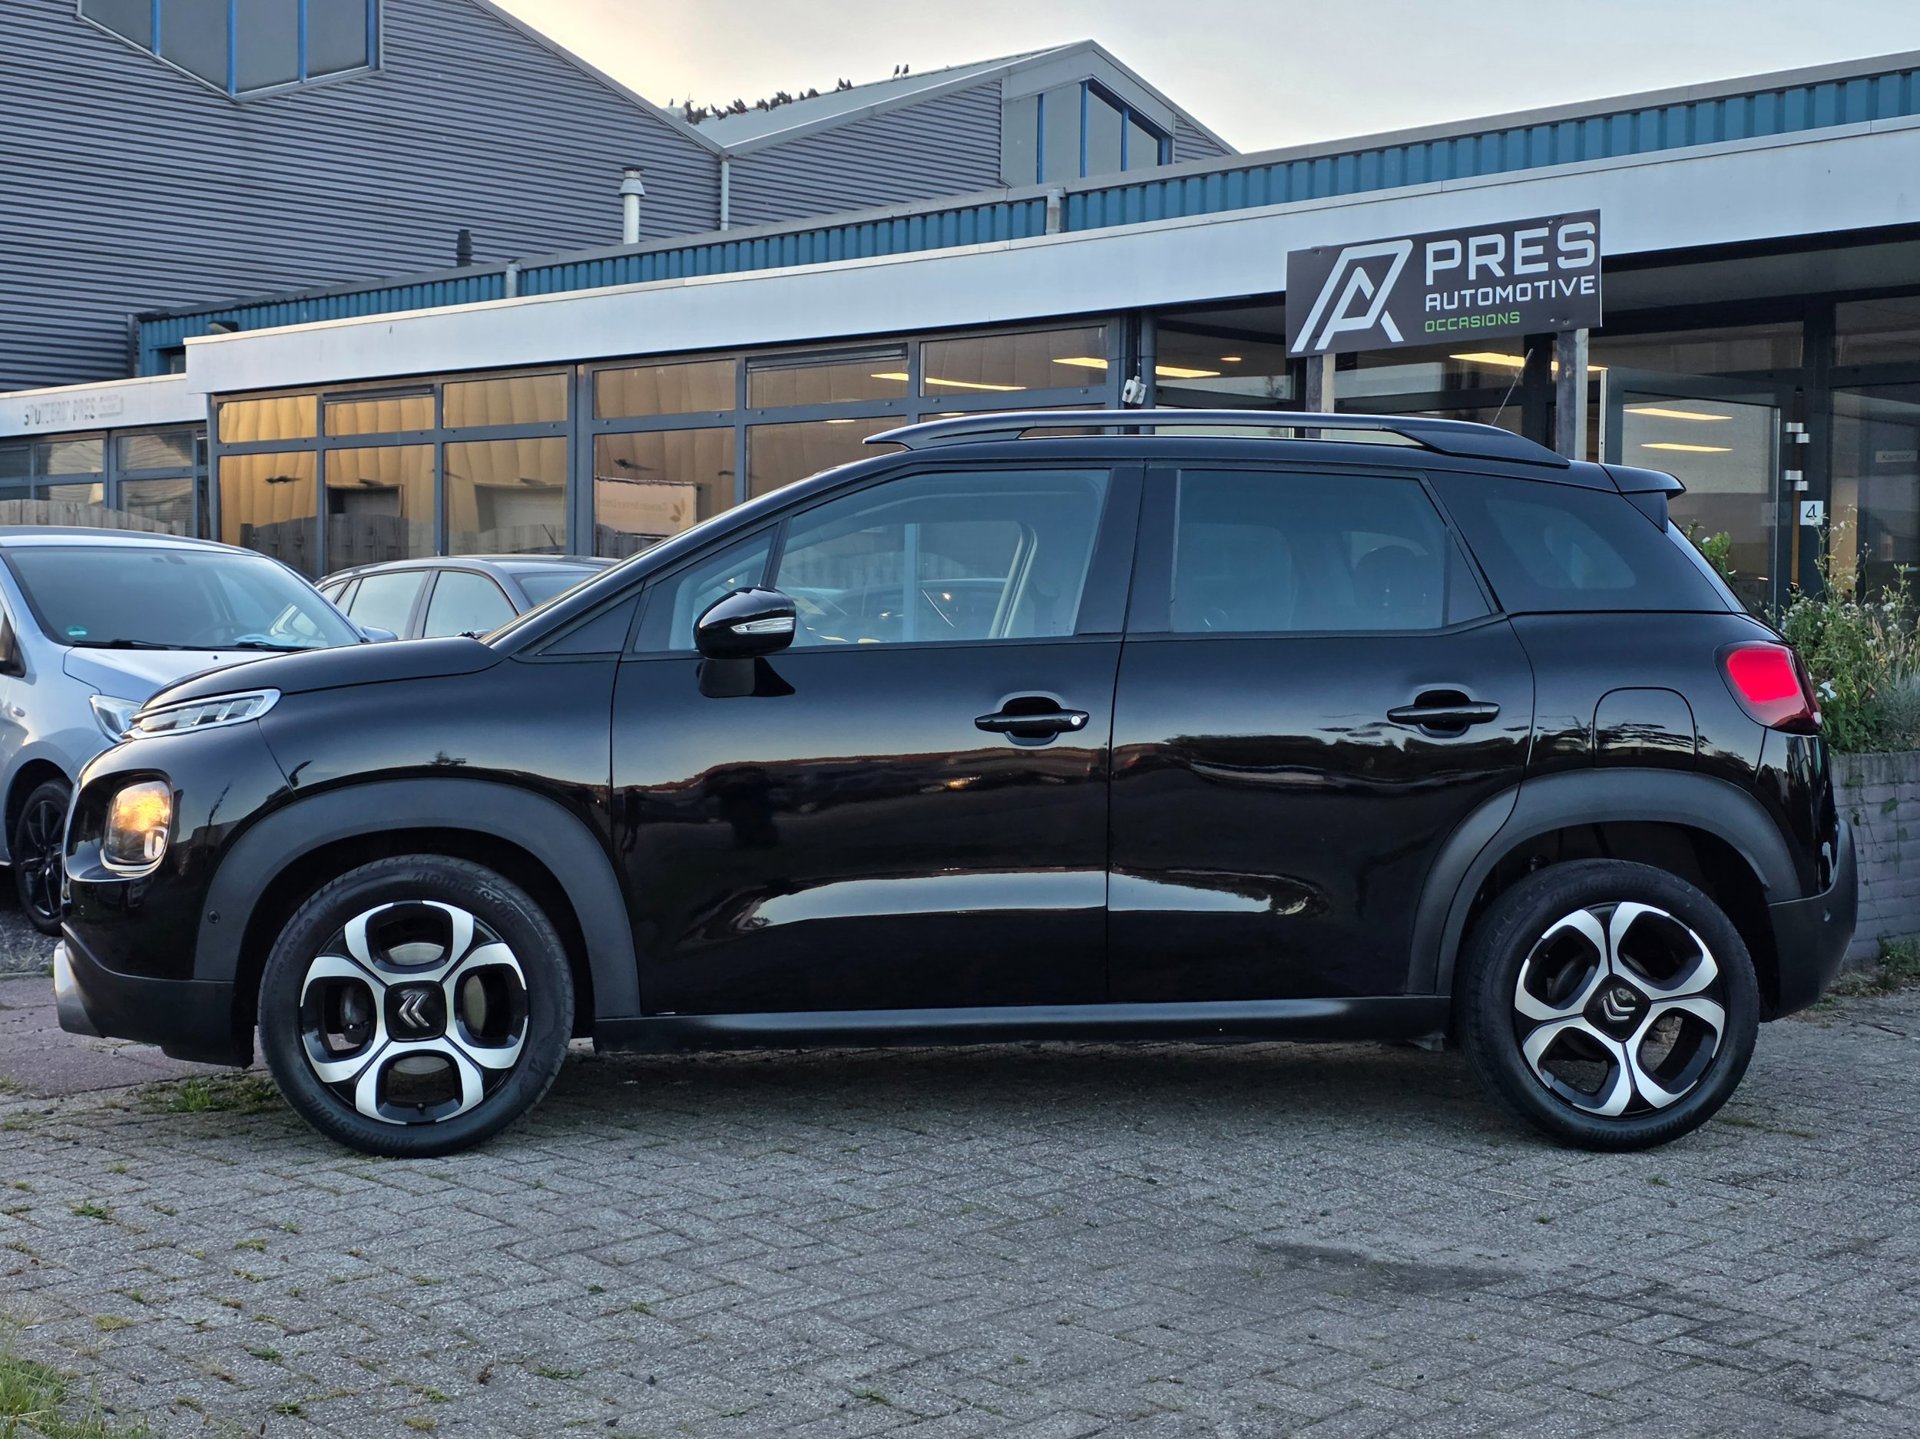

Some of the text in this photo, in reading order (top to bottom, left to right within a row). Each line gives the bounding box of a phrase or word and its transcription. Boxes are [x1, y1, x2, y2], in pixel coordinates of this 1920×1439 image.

[1425, 221, 1596, 286] PRES
[1425, 275, 1596, 312] AUTOMOTIVE
[1424, 311, 1521, 333] OCCASIONS
[1805, 503, 1818, 519] 4
